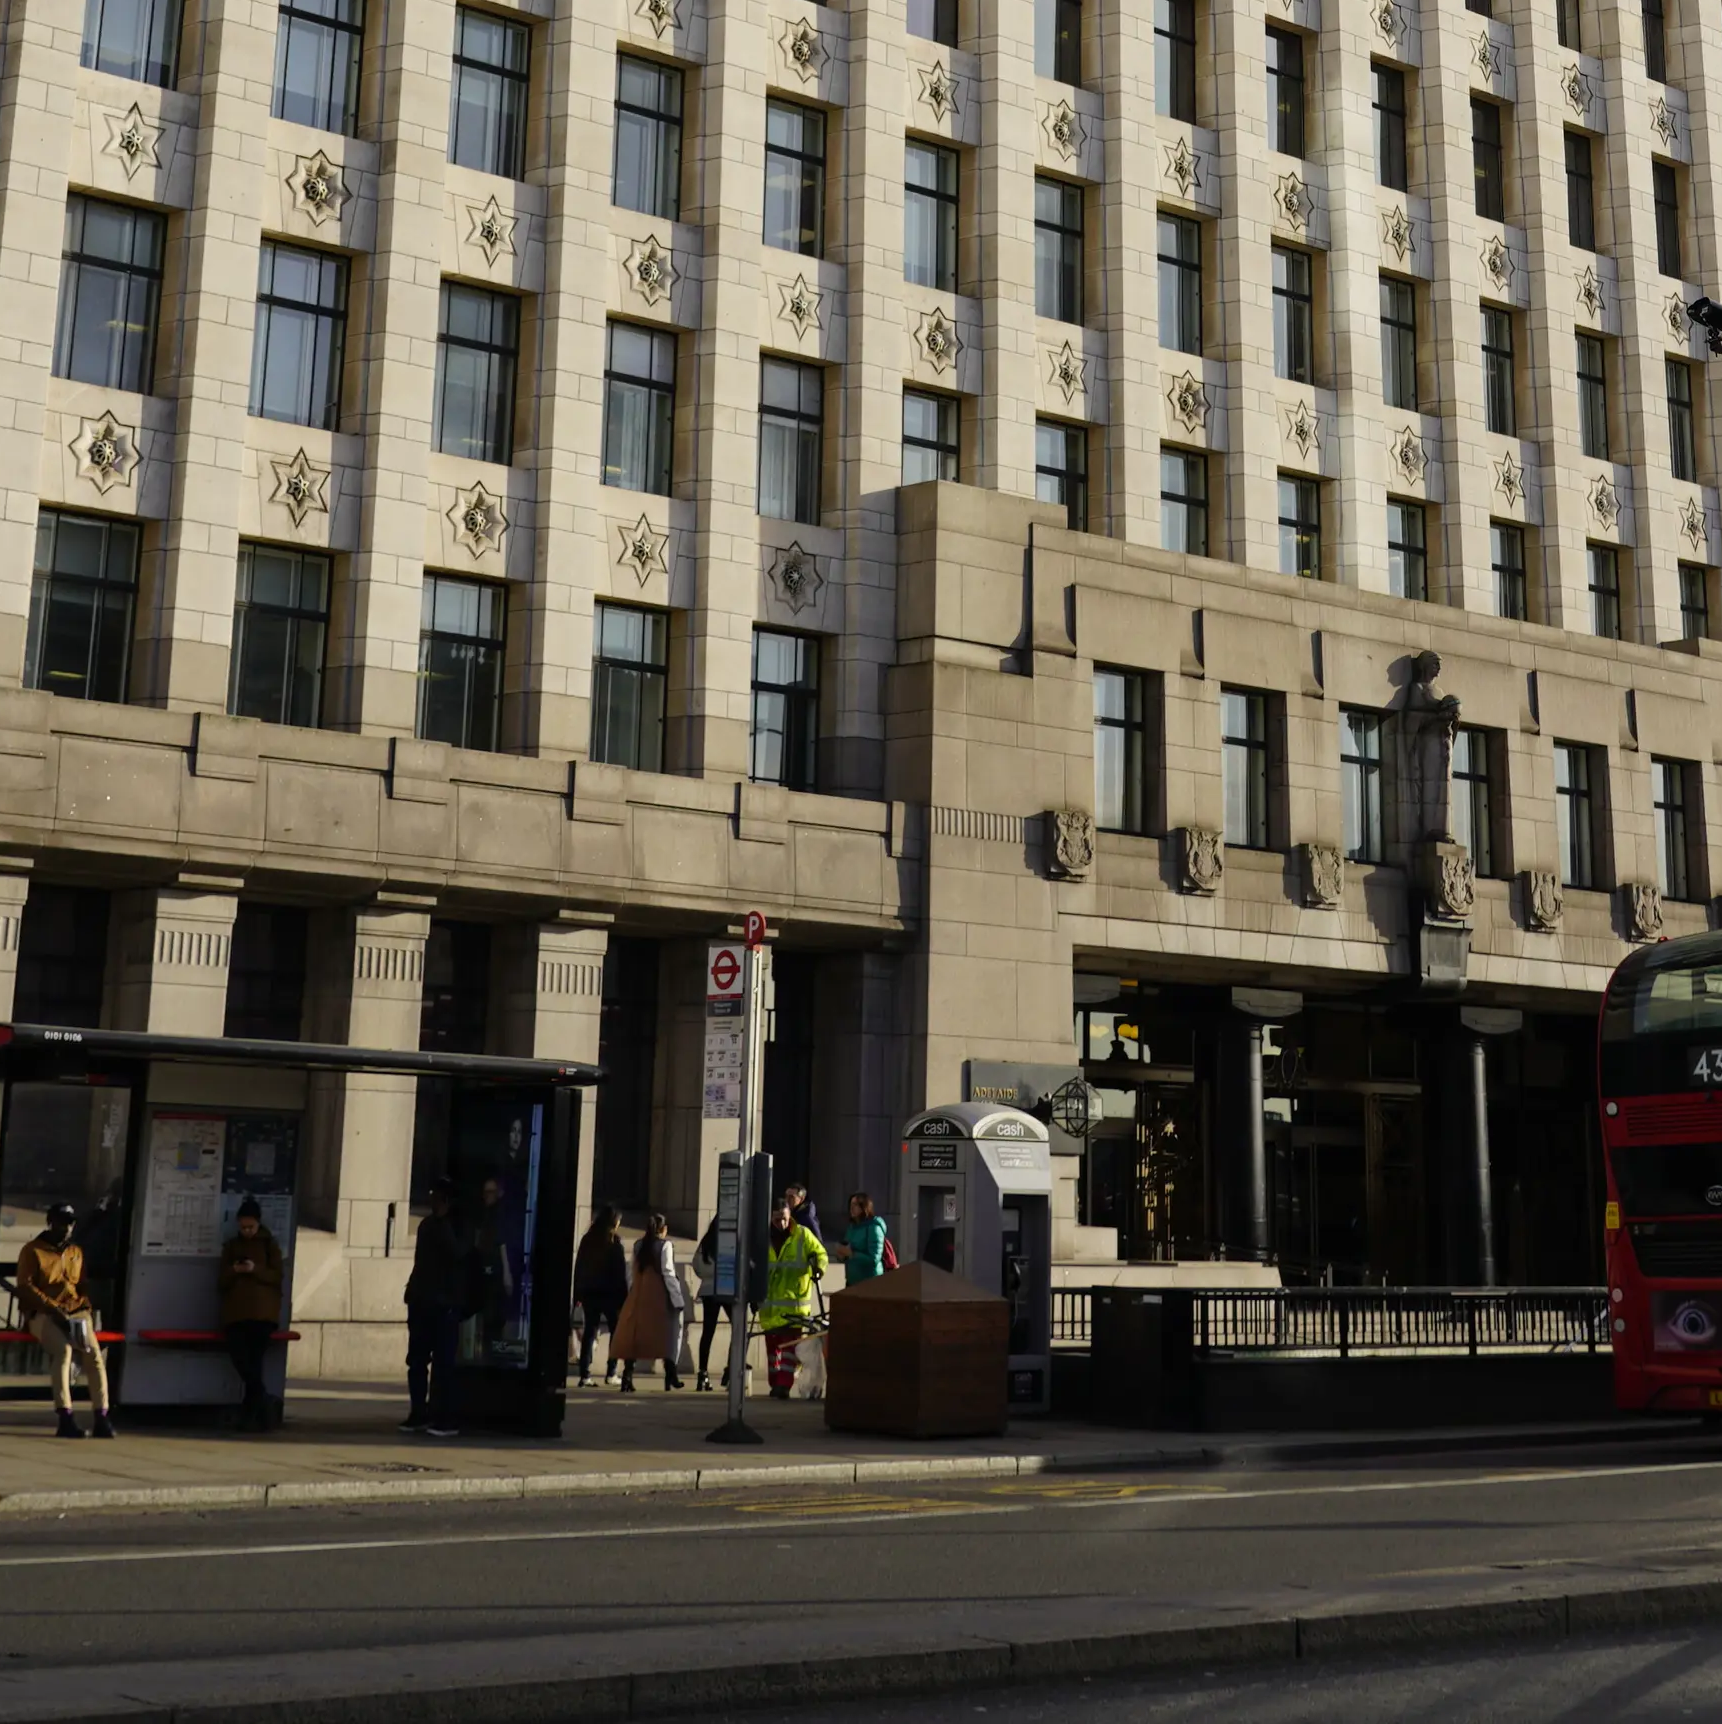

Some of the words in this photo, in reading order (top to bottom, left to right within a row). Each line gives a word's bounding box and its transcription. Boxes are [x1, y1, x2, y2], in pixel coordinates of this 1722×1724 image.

[748, 915, 760, 939] P
[923, 1119, 950, 1135] cash
[996, 1120, 1025, 1137] cash
